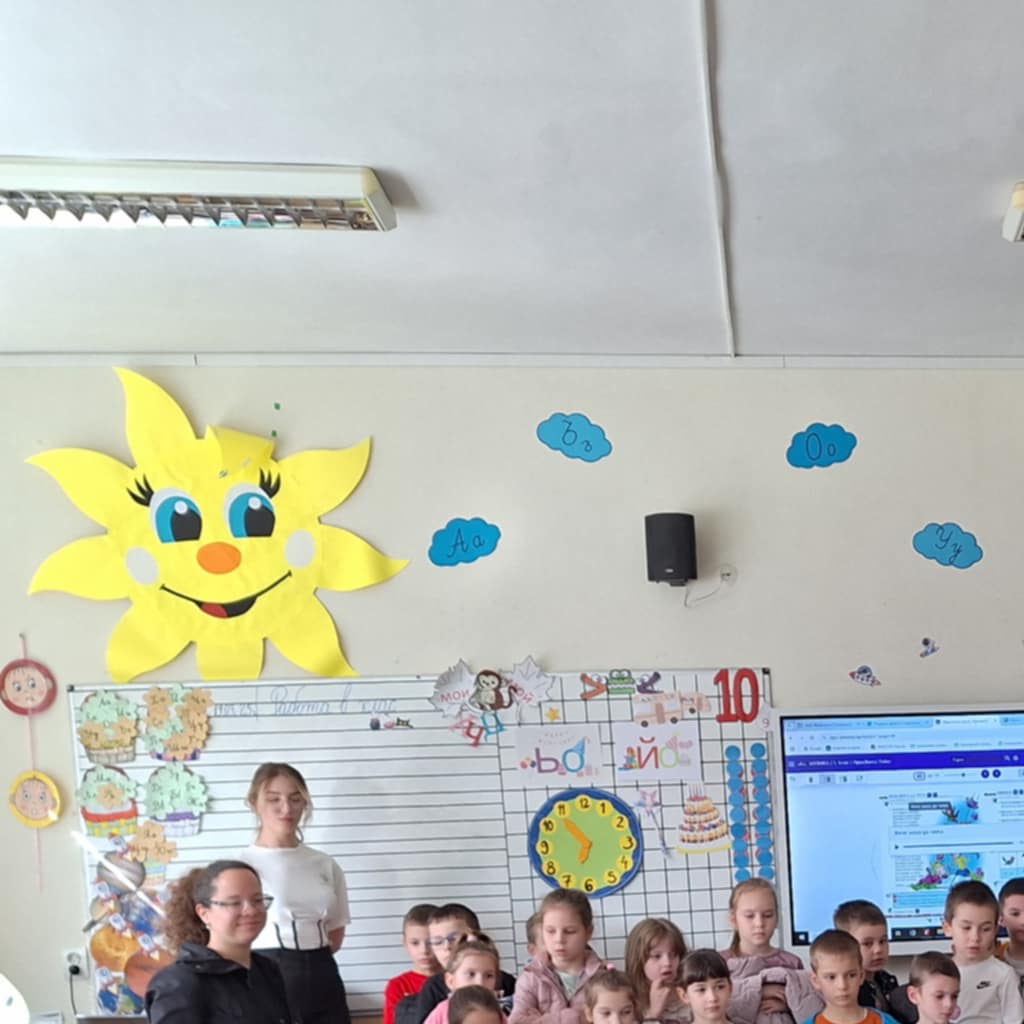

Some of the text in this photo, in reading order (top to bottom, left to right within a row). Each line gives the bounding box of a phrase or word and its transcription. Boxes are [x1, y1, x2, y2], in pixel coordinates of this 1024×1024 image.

[447, 528, 485, 558] Аа
[713, 668, 759, 723] 10
[579, 797, 591, 809] 12
[600, 802, 607, 814] 1
[557, 804, 567, 816] 11
[542, 819, 554, 832] 10
[615, 815, 625, 828] 2
[540, 841, 549, 854] 9
[623, 836, 634, 849] 3
[546, 861, 556, 875] 8
[619, 857, 629, 870] 4
[562, 875, 572, 887] 7
[607, 871, 617, 884] 5
[584, 878, 594, 893] 6
